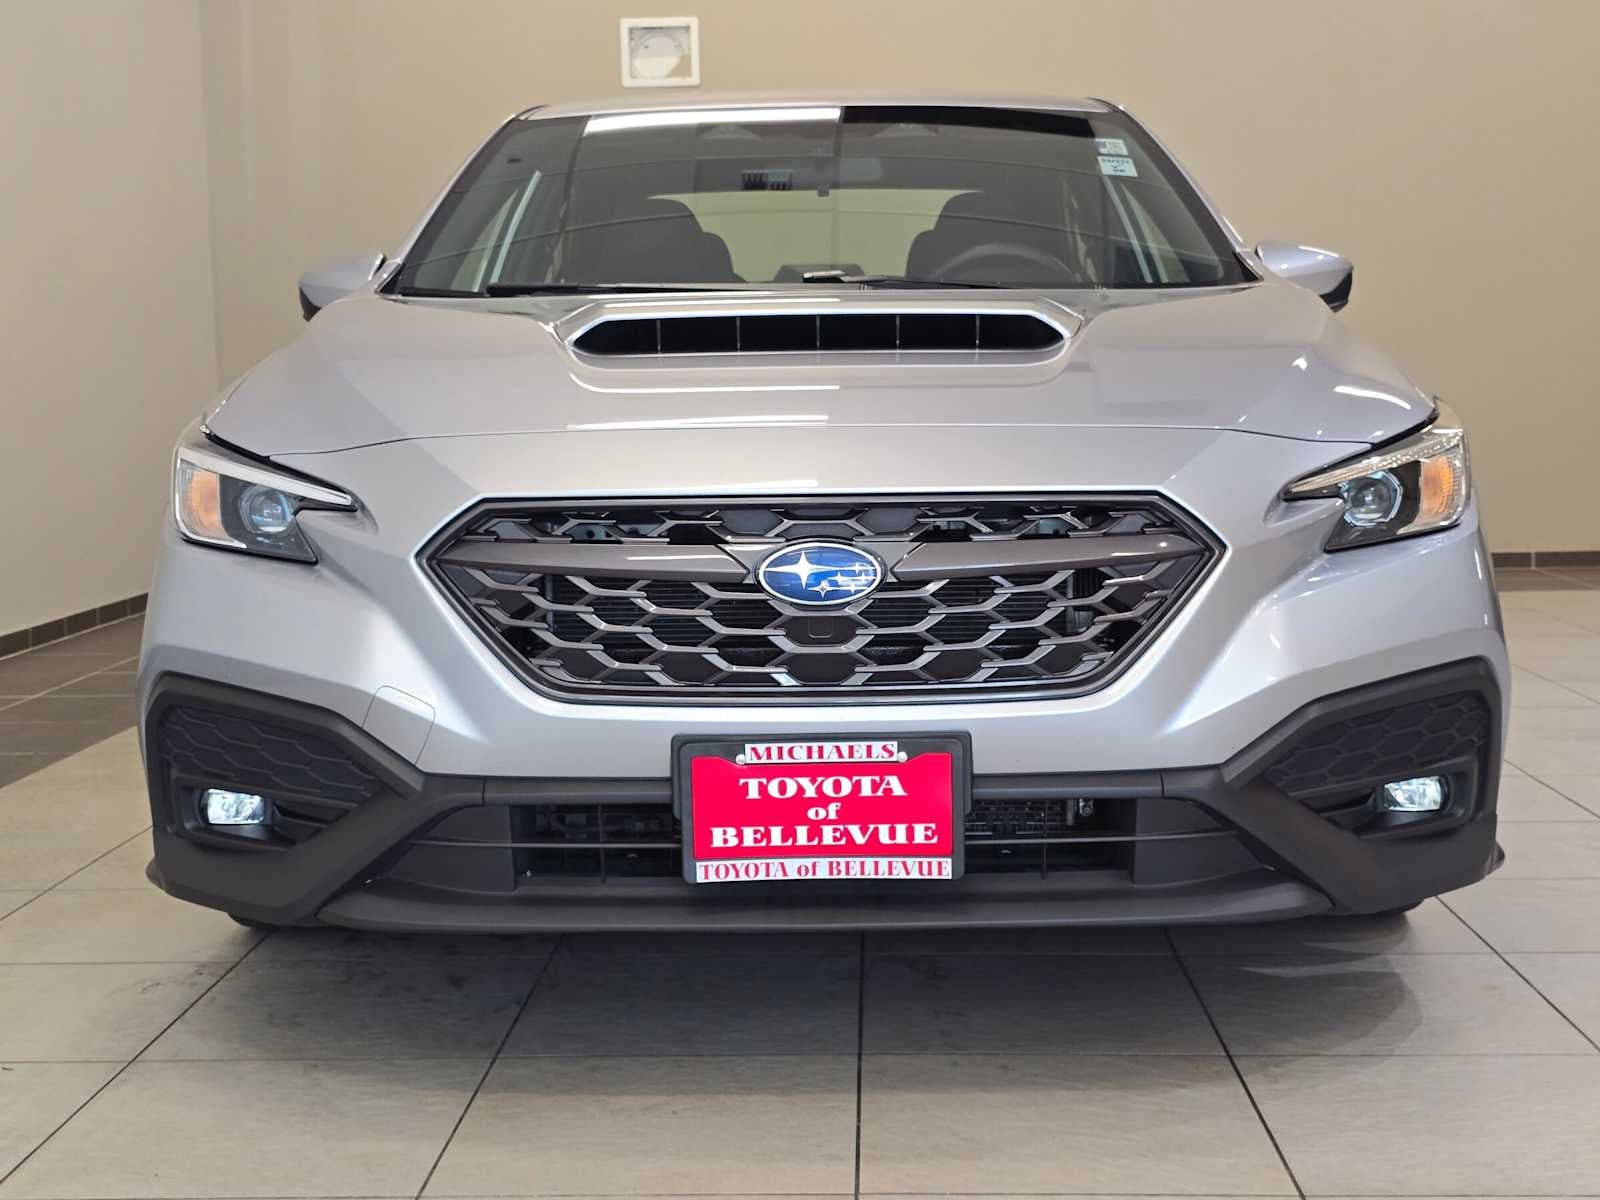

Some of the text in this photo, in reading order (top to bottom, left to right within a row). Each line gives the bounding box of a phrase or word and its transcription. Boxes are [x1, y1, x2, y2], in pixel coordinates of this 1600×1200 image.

[749, 744, 896, 761] MICHAELS
[739, 775, 907, 799] TOYOTA
[807, 802, 841, 820] of
[710, 823, 938, 847] BELLEVUE
[699, 859, 950, 880] TOYOTA of BELLEVUE
